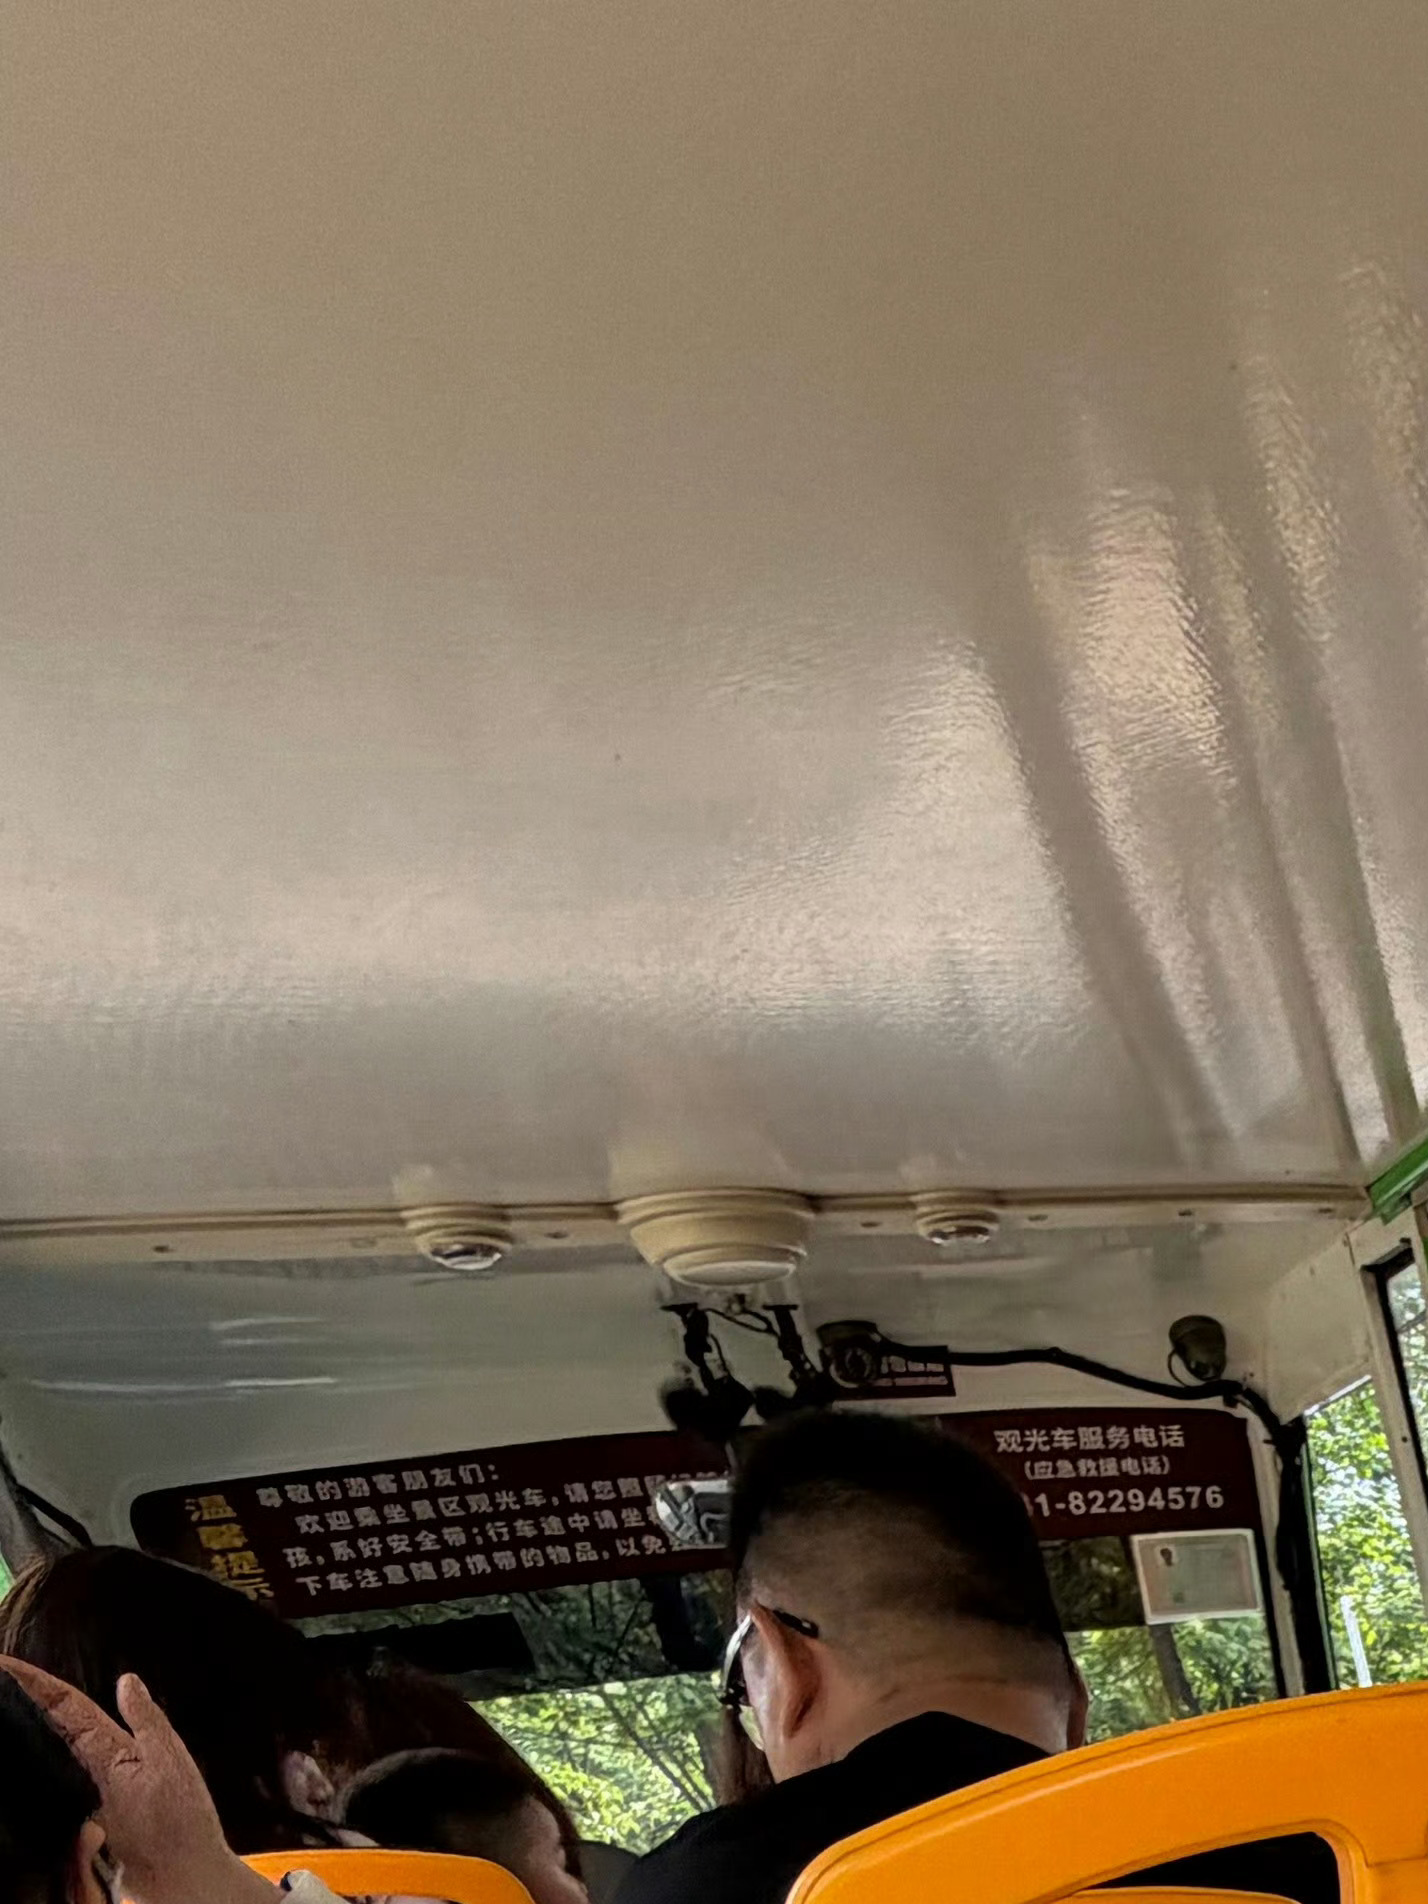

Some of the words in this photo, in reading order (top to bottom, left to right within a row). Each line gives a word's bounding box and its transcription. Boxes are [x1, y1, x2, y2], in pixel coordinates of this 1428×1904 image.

[993, 1424, 1186, 1454] 观光车服务电话
[1024, 1484, 1226, 1518] 1-82294576
[296, 1534, 676, 1596] 下车注意随身携带的物品，以免
